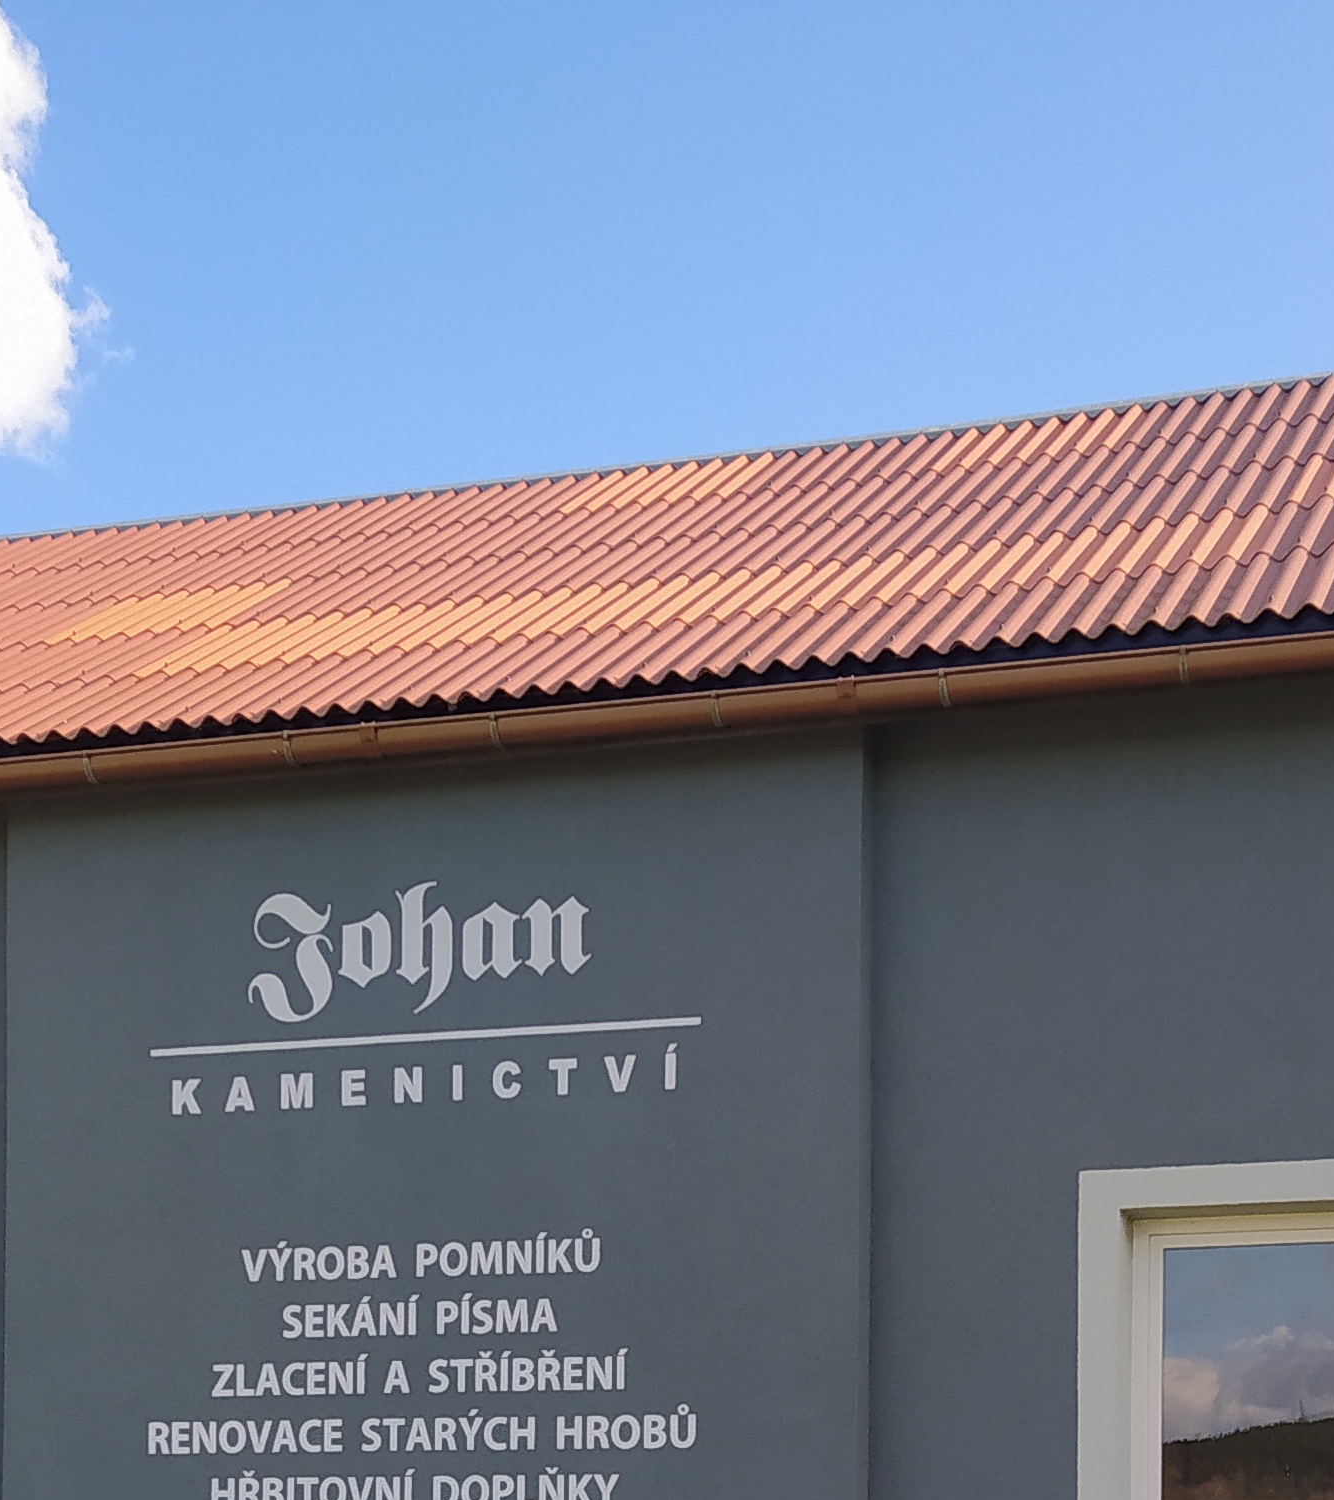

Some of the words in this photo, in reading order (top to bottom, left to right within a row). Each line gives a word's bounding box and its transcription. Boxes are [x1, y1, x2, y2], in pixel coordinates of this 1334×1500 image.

[247, 881, 592, 1023] Johan
[171, 1043, 677, 1115] KAMENICTVÍ
[241, 1241, 397, 1282] VÝROBA
[416, 1228, 600, 1278] POMNÍKŮ
[282, 1294, 419, 1338] SEKÁNÍ
[437, 1293, 557, 1334] PÍSMA
[212, 1354, 368, 1397] ZLACENÍ
[384, 1360, 410, 1394] A
[428, 1348, 629, 1392] STŘÍBŘENÍ
[148, 1419, 343, 1454] RENOVACE
[361, 1409, 536, 1452] STARÝCH
[556, 1404, 696, 1450] HROBŮ
